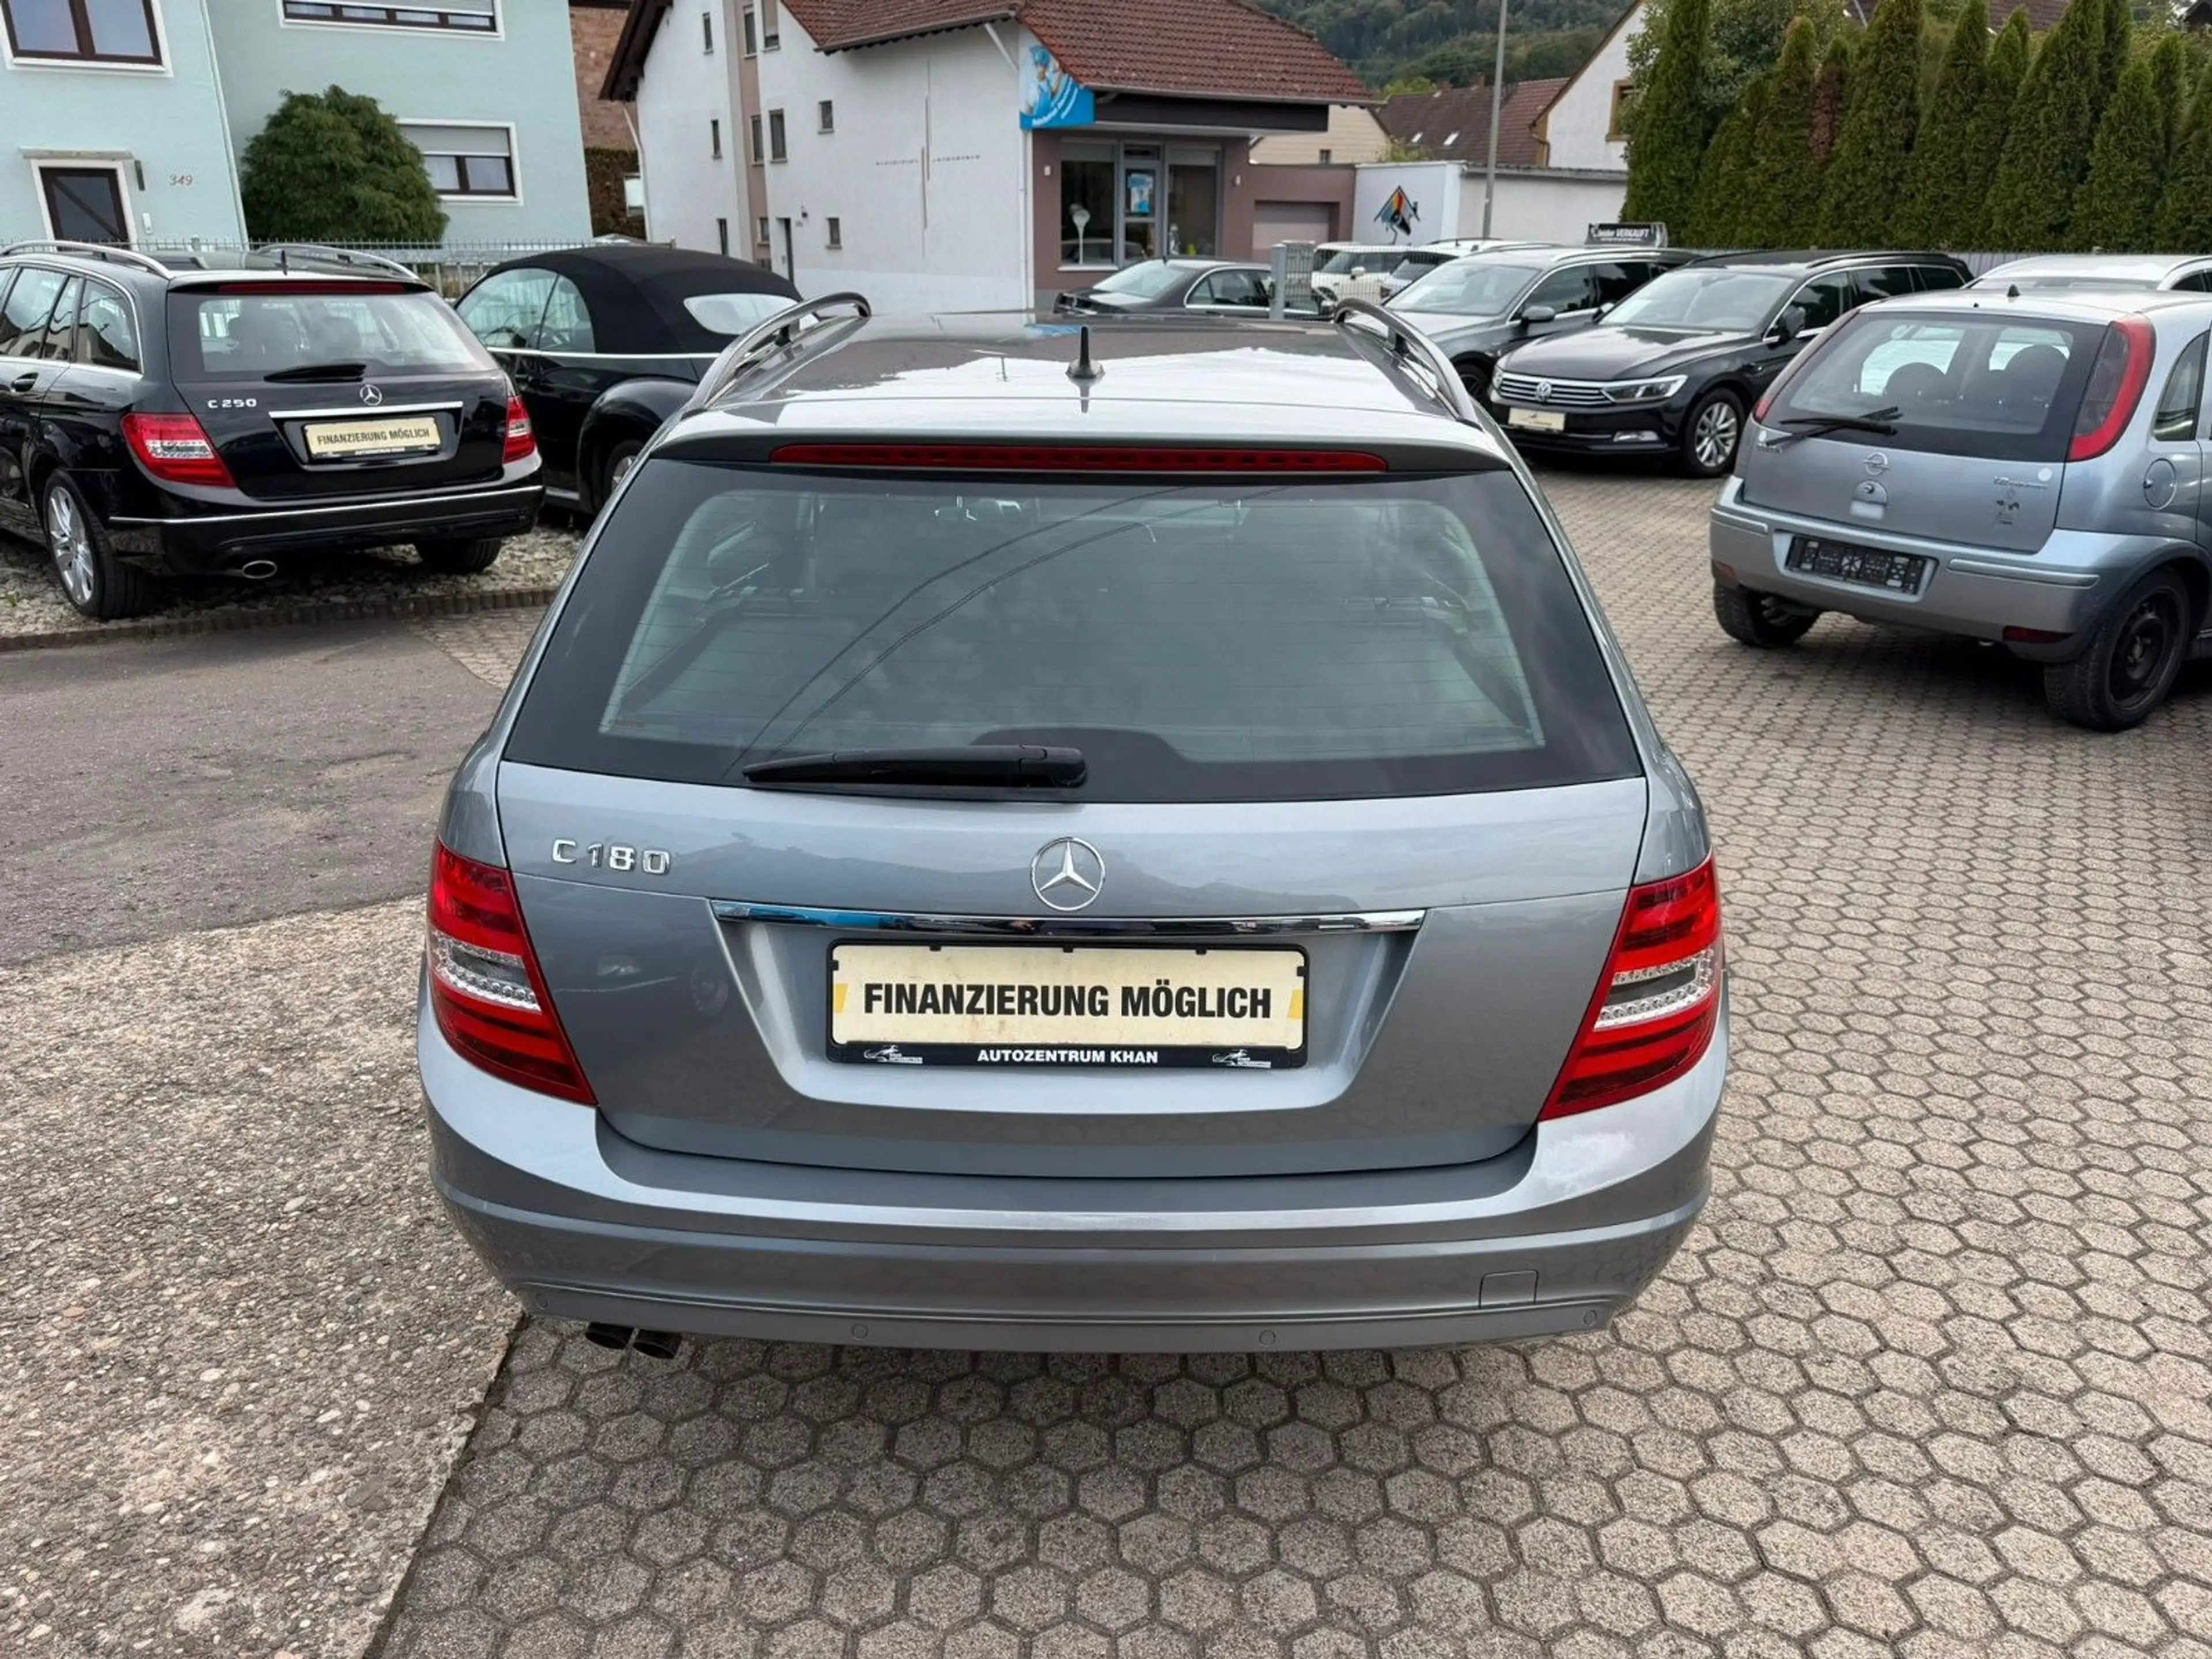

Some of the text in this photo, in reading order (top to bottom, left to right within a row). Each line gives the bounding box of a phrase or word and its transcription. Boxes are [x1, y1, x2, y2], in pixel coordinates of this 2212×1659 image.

[169, 175, 193, 186] 349
[208, 398, 256, 409] C 250
[317, 428, 430, 445] FINANZIERUNG MÖGLICH
[552, 839, 671, 874] C 180
[864, 979, 1271, 1018] FINANZIERUNG MÖGLICH
[978, 1049, 1158, 1064] AUTOZENTRUM KHAN
